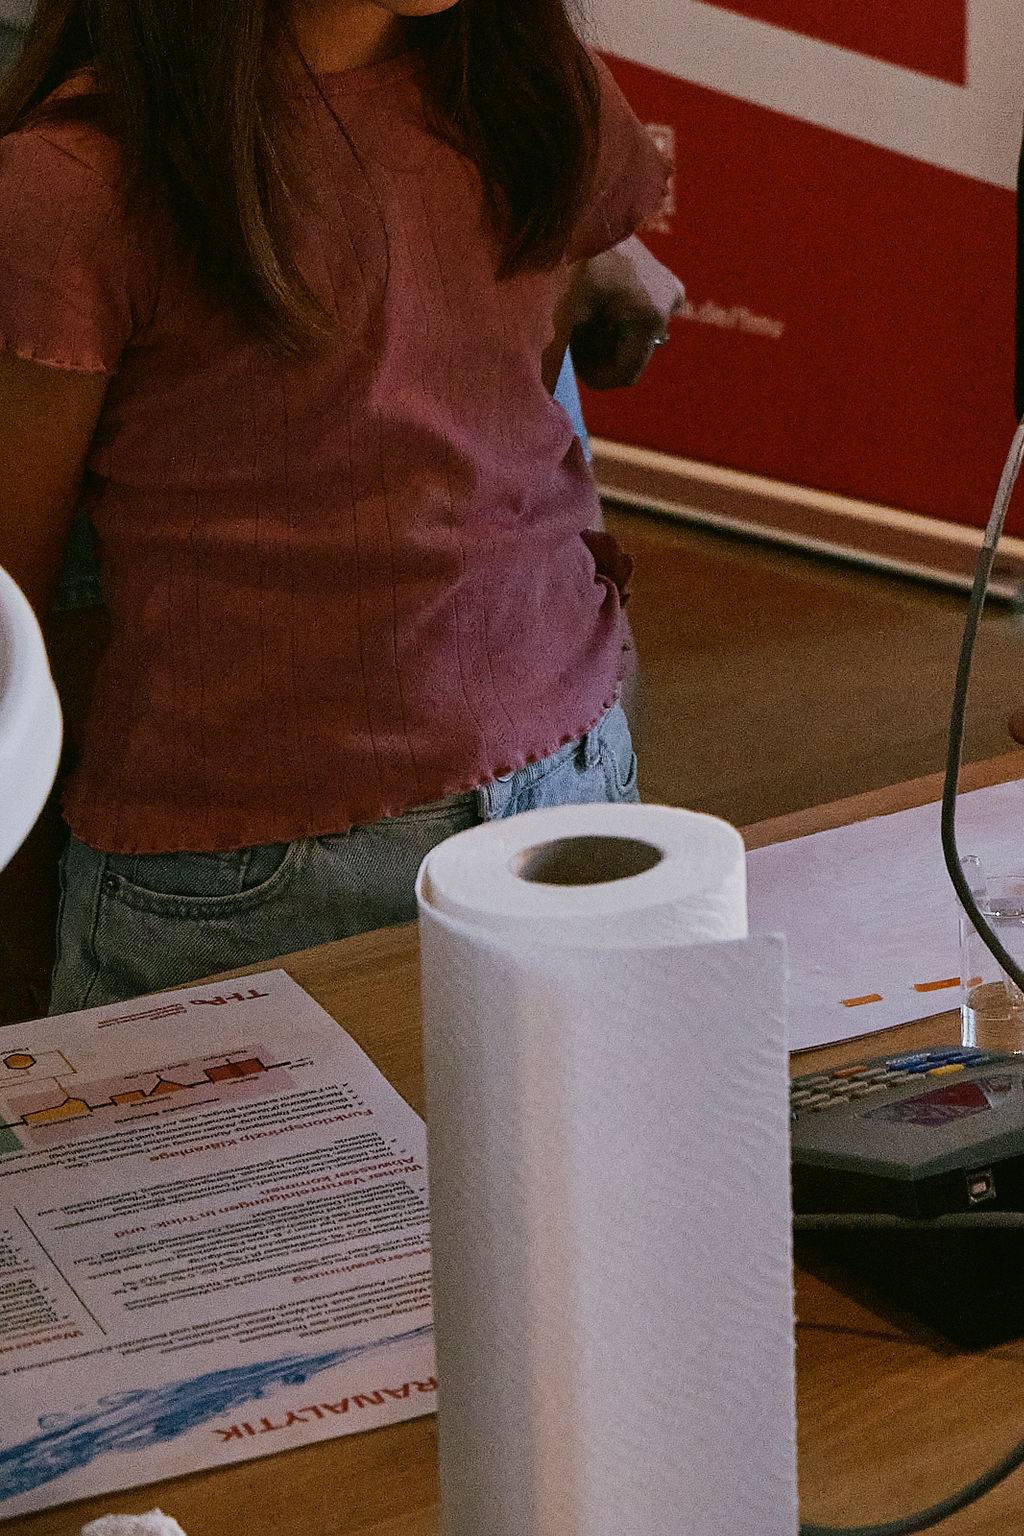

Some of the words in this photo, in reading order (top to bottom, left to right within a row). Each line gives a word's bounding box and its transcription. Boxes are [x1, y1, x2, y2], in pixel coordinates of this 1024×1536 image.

[333, 1155, 416, 1181] Abwasser
[113, 1225, 145, 1239] und
[213, 1376, 440, 1442] RANALYTIK
